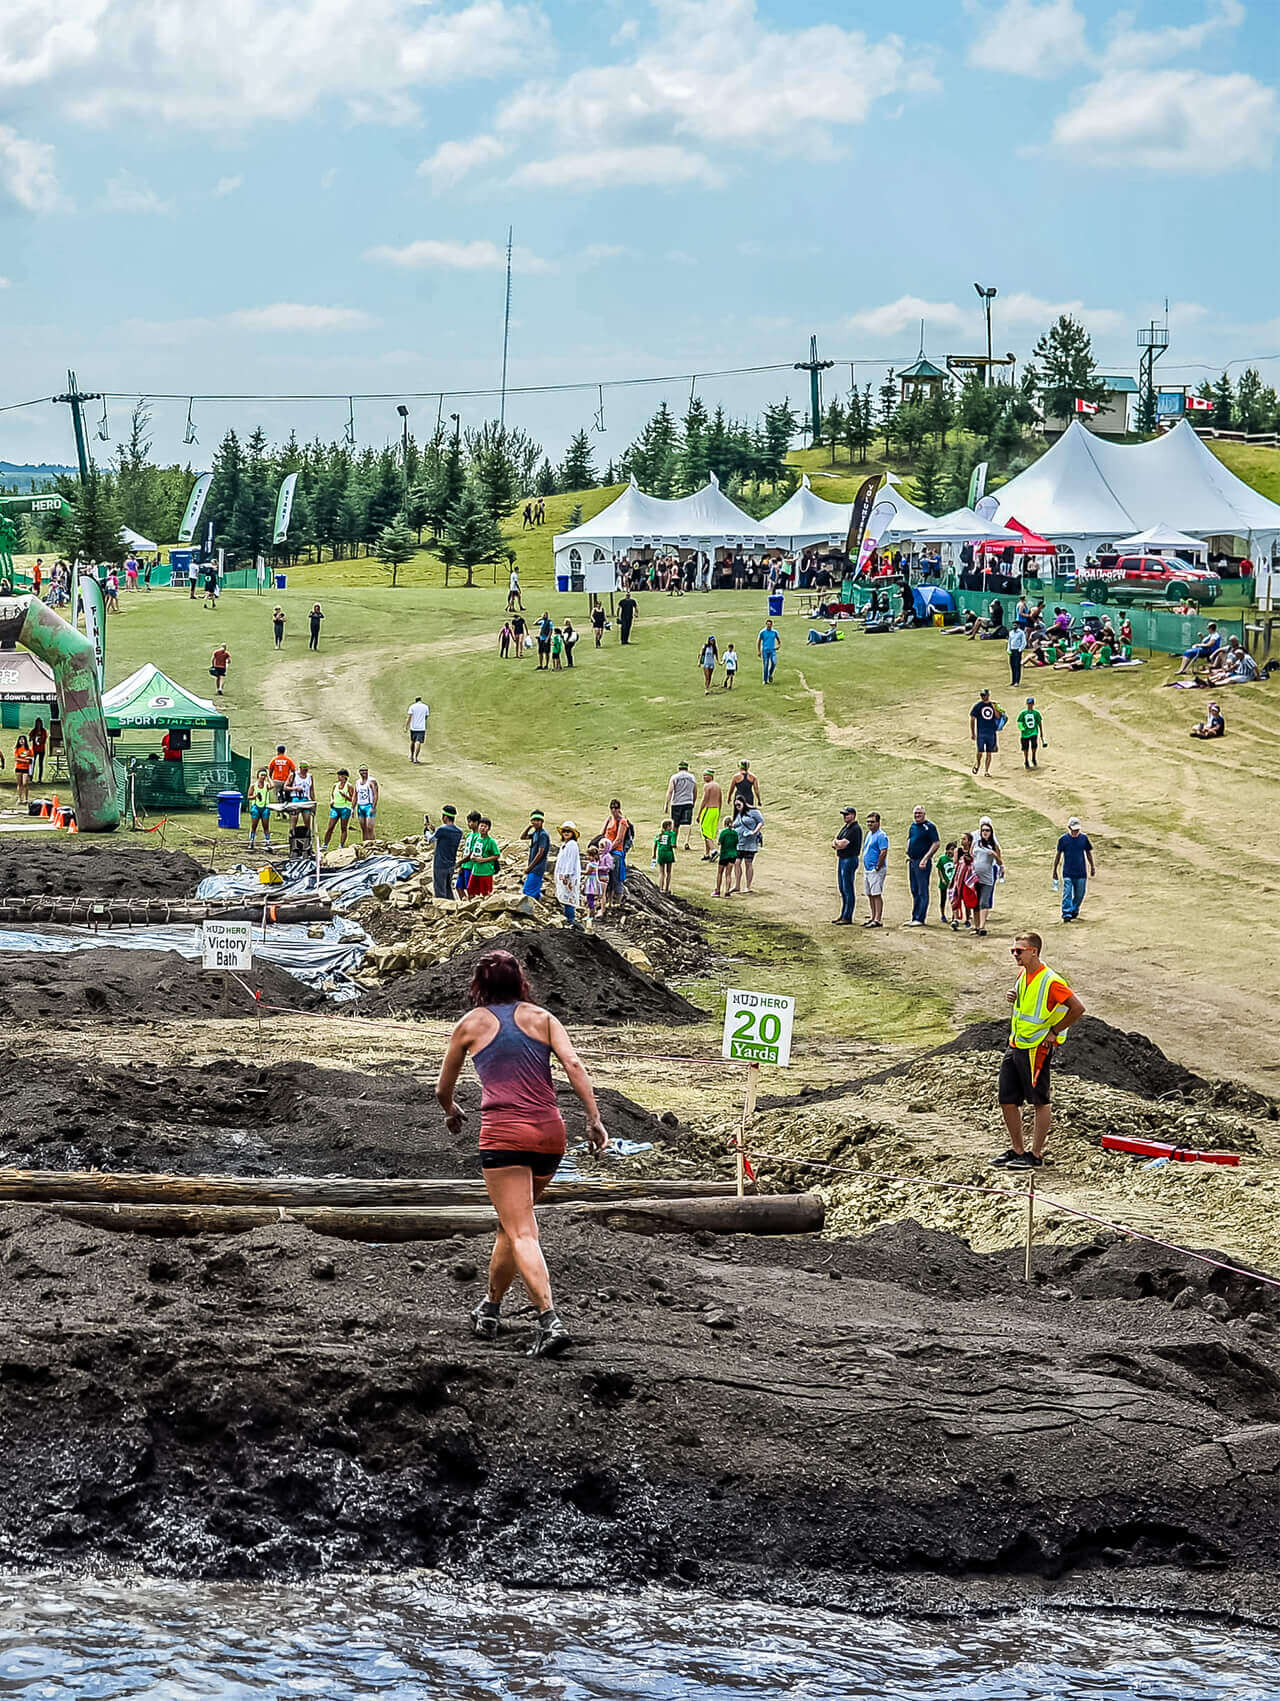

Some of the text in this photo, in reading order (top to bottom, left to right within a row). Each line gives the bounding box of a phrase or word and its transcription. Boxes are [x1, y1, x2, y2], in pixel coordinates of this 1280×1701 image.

[32, 499, 62, 511] HERO
[91, 606, 102, 666] FINISH
[206, 925, 225, 934] MUD
[208, 936, 247, 952] Victory
[216, 951, 238, 966] Bath
[732, 994, 789, 1009] MUD HERO
[731, 1009, 782, 1044] 20
[733, 1042, 777, 1061] Yards
